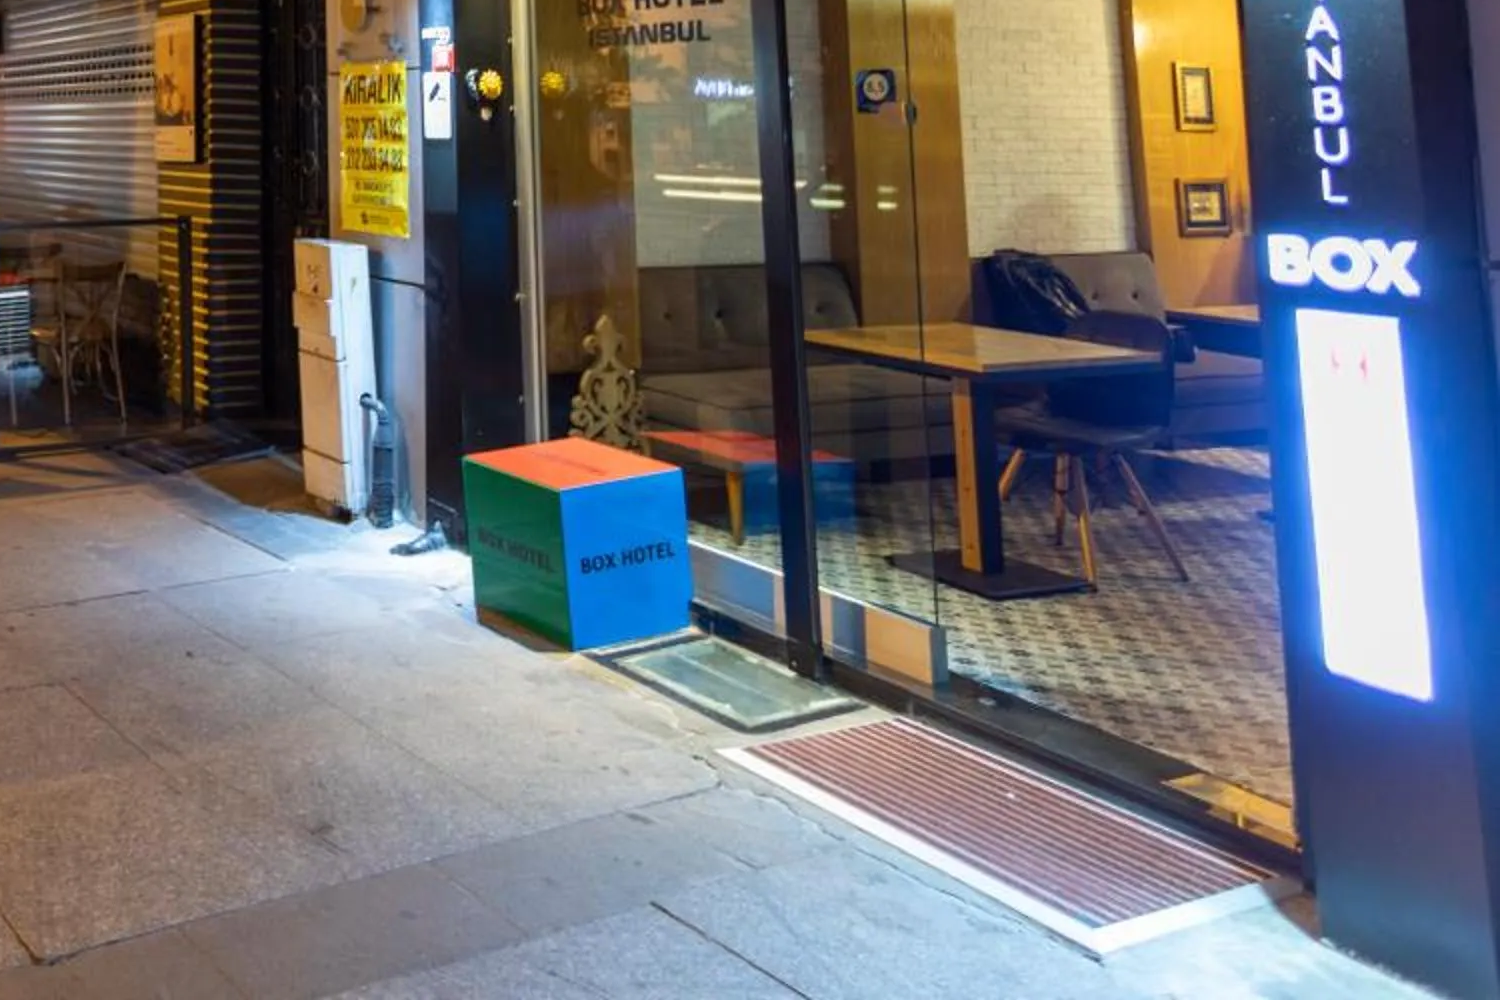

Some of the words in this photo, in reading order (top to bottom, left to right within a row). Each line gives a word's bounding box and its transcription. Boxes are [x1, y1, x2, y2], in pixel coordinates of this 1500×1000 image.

[1267, 233, 1422, 297] BOX
[580, 553, 617, 574] BOX
[621, 542, 675, 567] HOTEL
